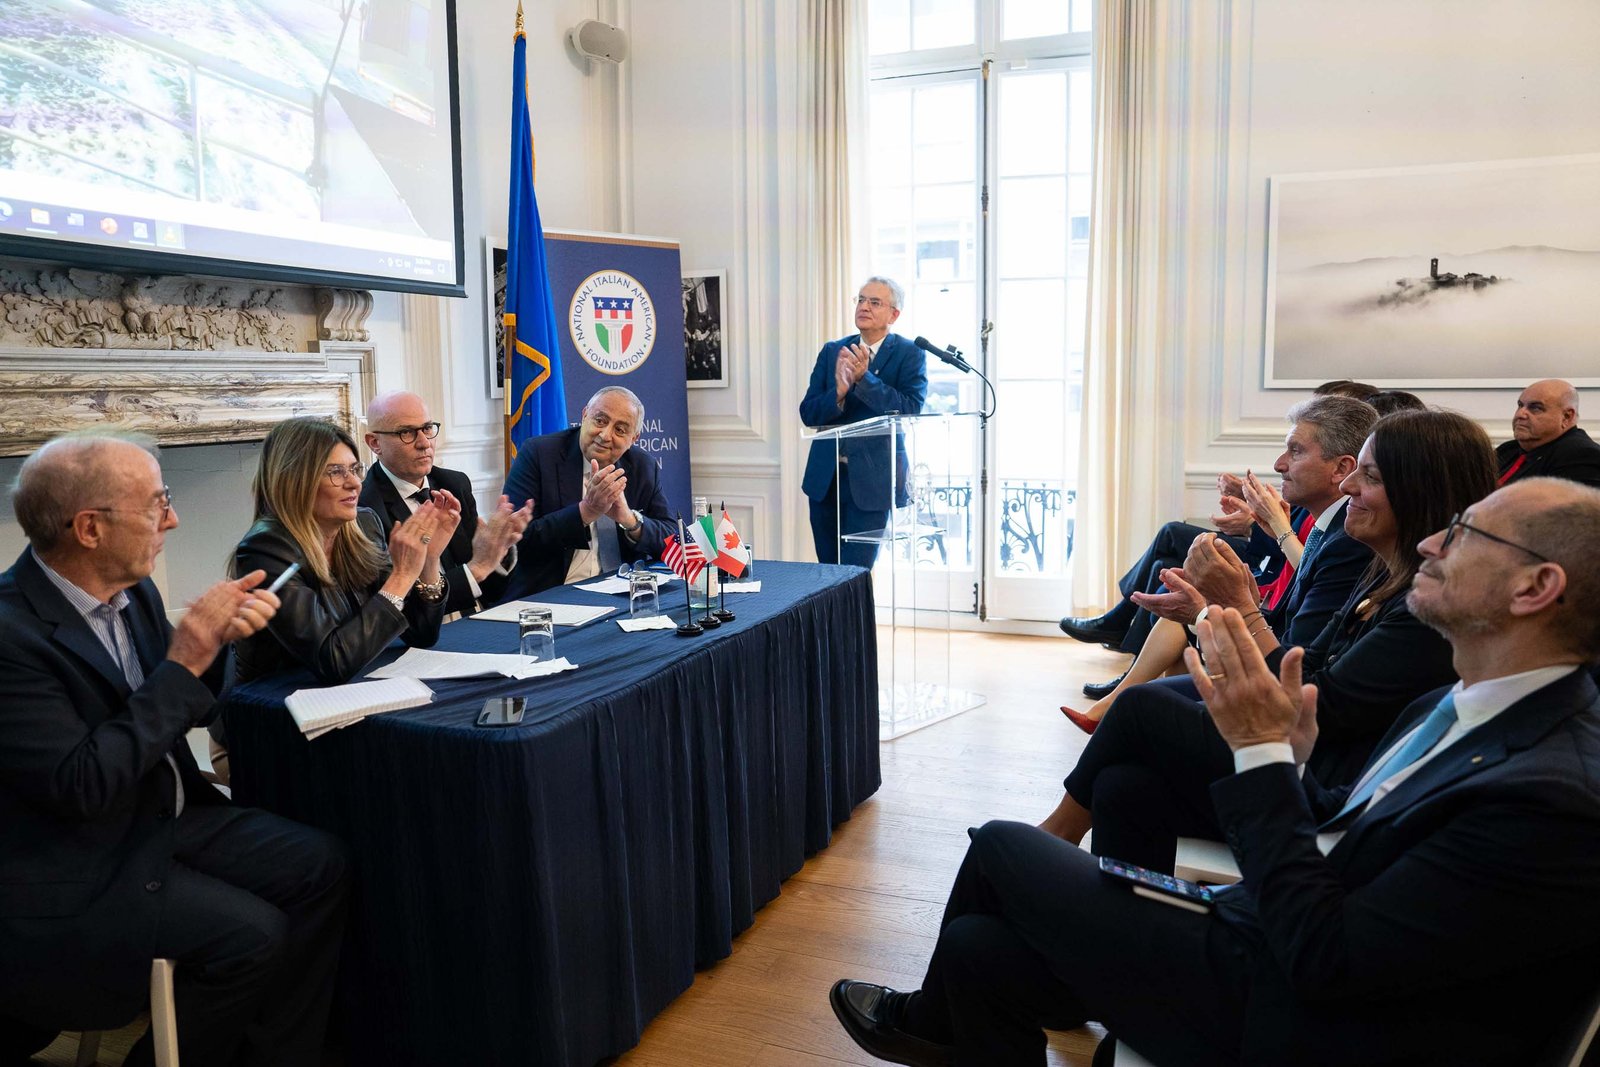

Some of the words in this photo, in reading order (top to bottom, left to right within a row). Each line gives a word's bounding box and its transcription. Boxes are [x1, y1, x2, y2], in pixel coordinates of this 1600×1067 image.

[574, 285, 593, 341] NATIONAL
[593, 275, 631, 289] ITALIAN
[631, 287, 653, 341] AMERICAN
[586, 348, 644, 370] FOUNDATION
